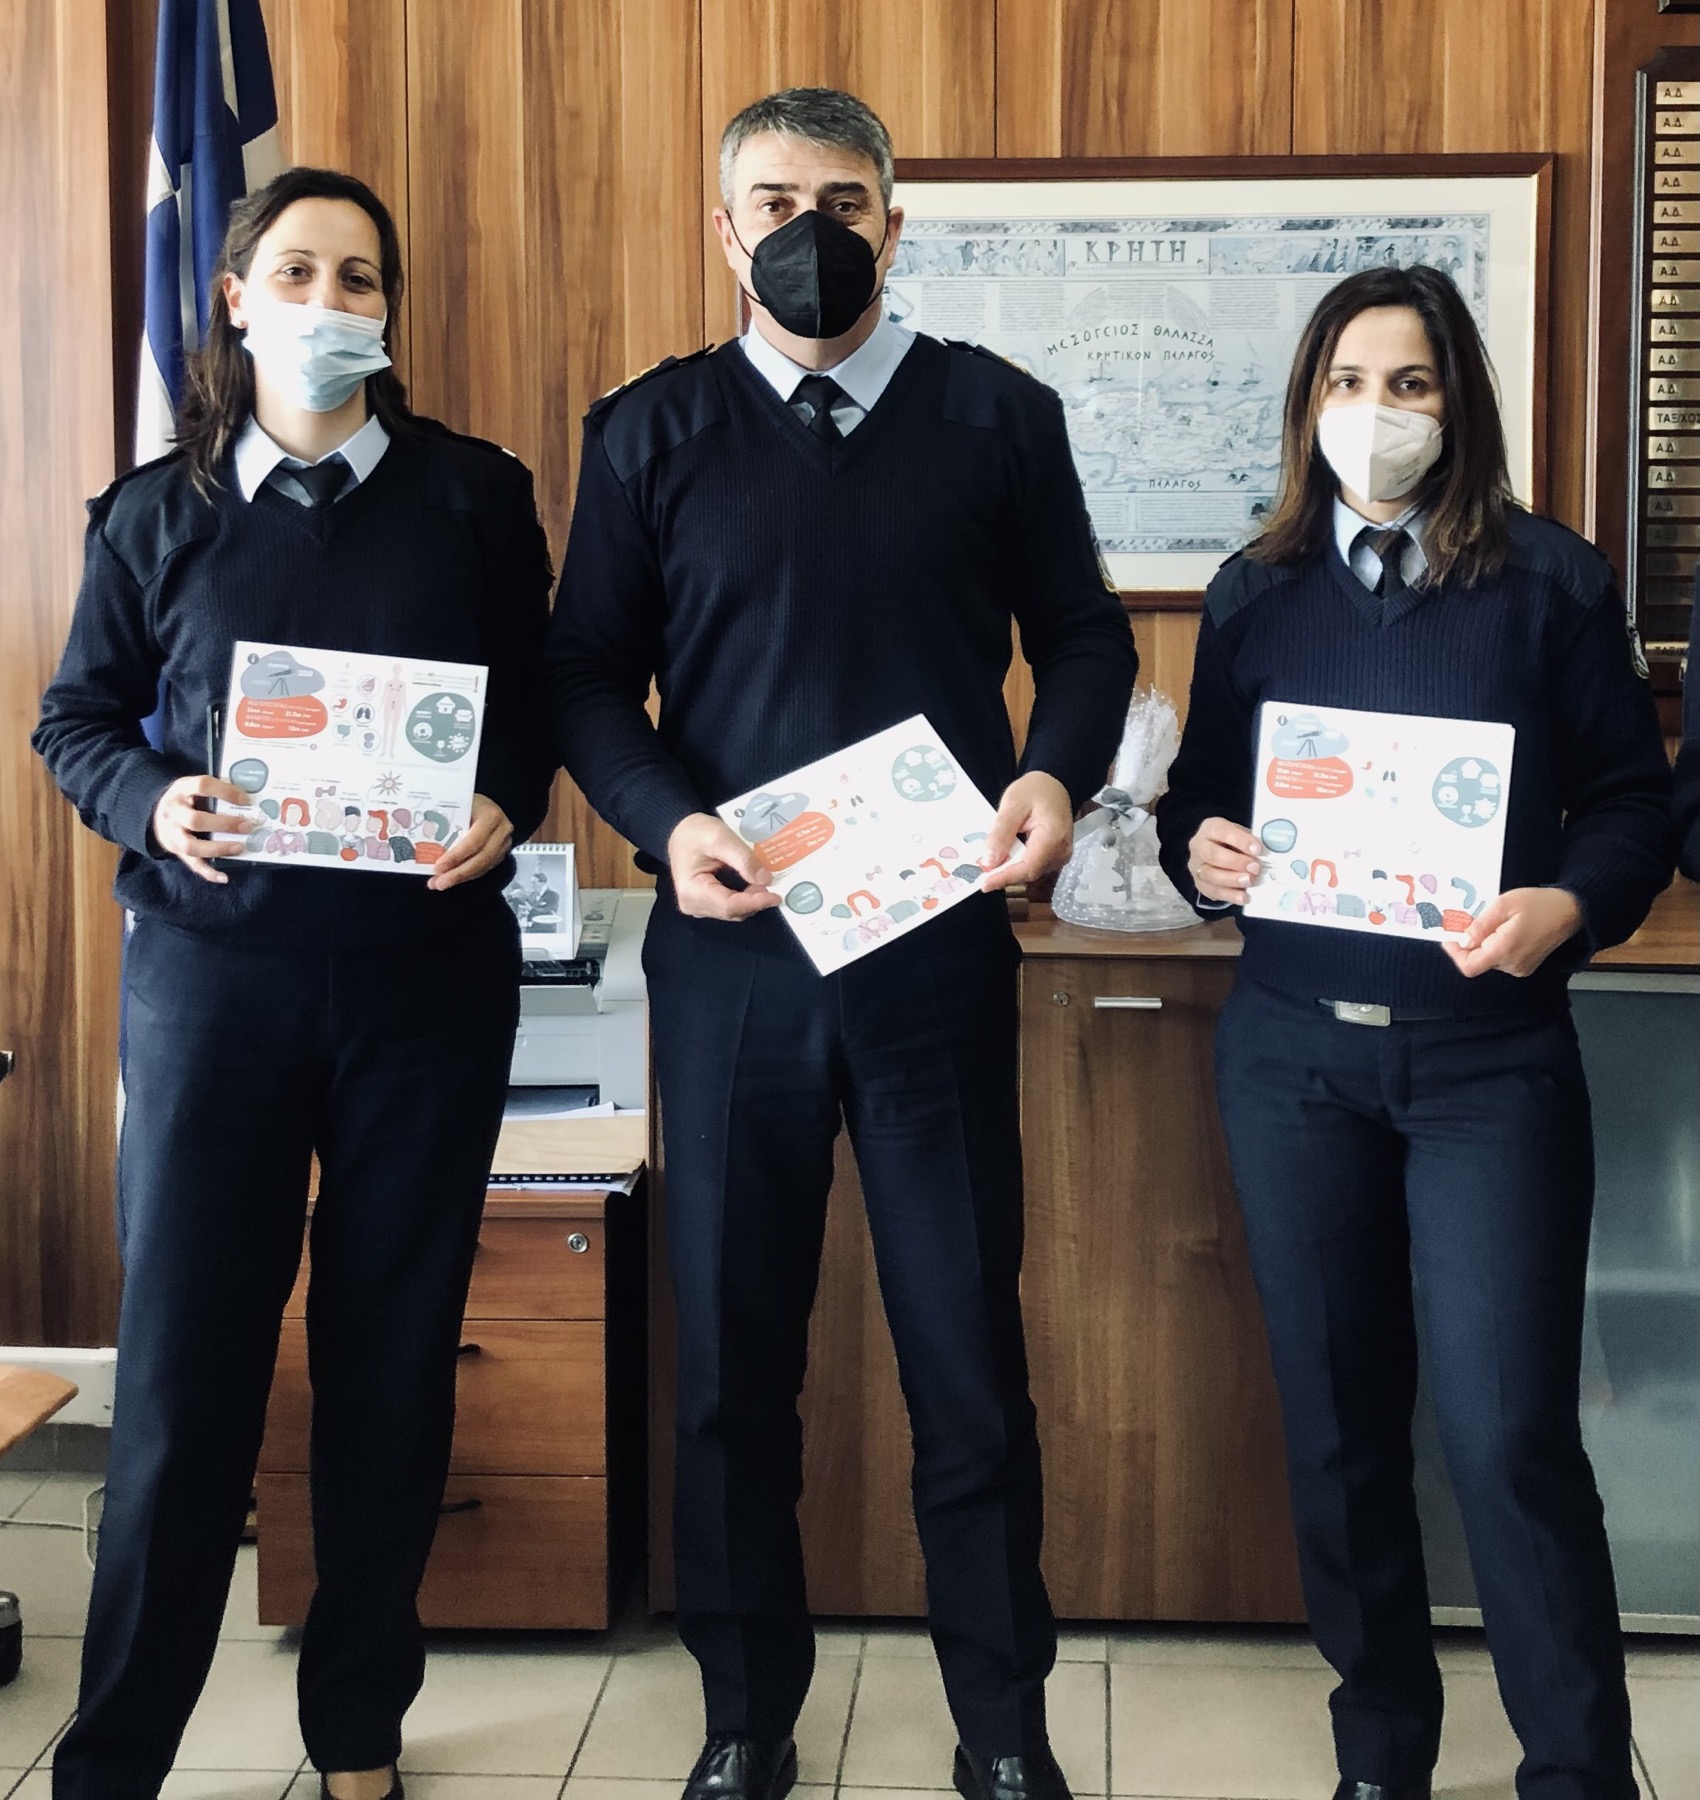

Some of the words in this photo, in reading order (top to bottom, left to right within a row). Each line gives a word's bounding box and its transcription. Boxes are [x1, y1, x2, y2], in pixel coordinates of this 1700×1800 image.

[1085, 240, 1187, 262] ΚΡΗΤΗ
[1153, 325, 1214, 348] ΘΑΛΑΣΣΑ
[1087, 351, 1152, 361] ΚΡΗΤΙΚΟΝ
